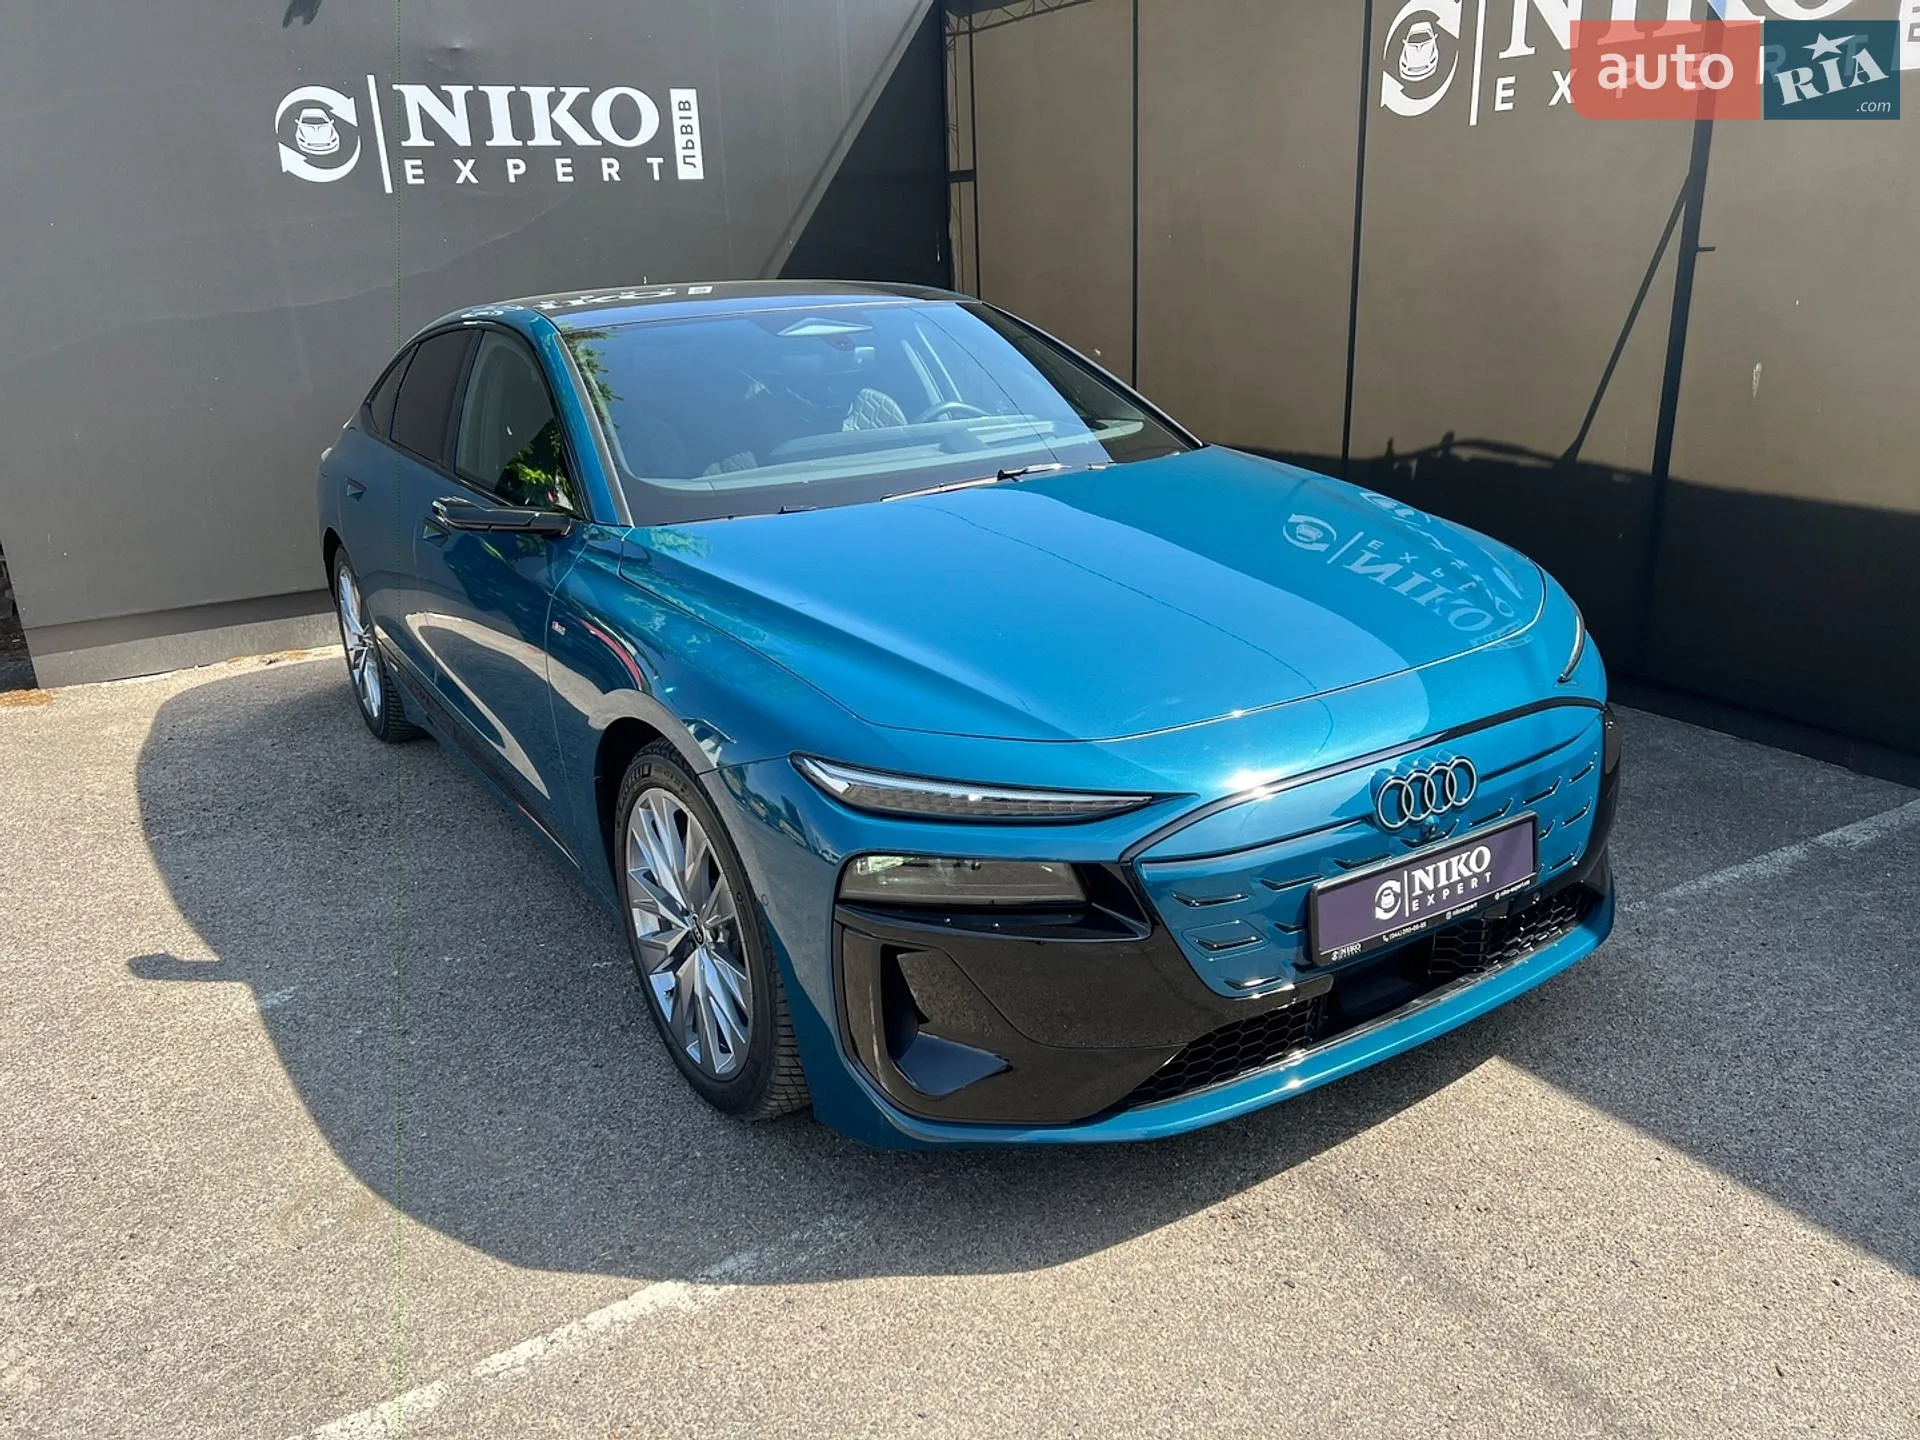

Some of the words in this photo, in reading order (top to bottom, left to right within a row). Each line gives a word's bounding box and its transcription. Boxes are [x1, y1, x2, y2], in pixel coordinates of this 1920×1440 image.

[392, 83, 660, 148] NIKO
[677, 99, 698, 169] ЛЬВІВ
[405, 156, 664, 185] EXPERT
[1411, 845, 1491, 897] NIKO
[1411, 871, 1492, 912] EXPERT
